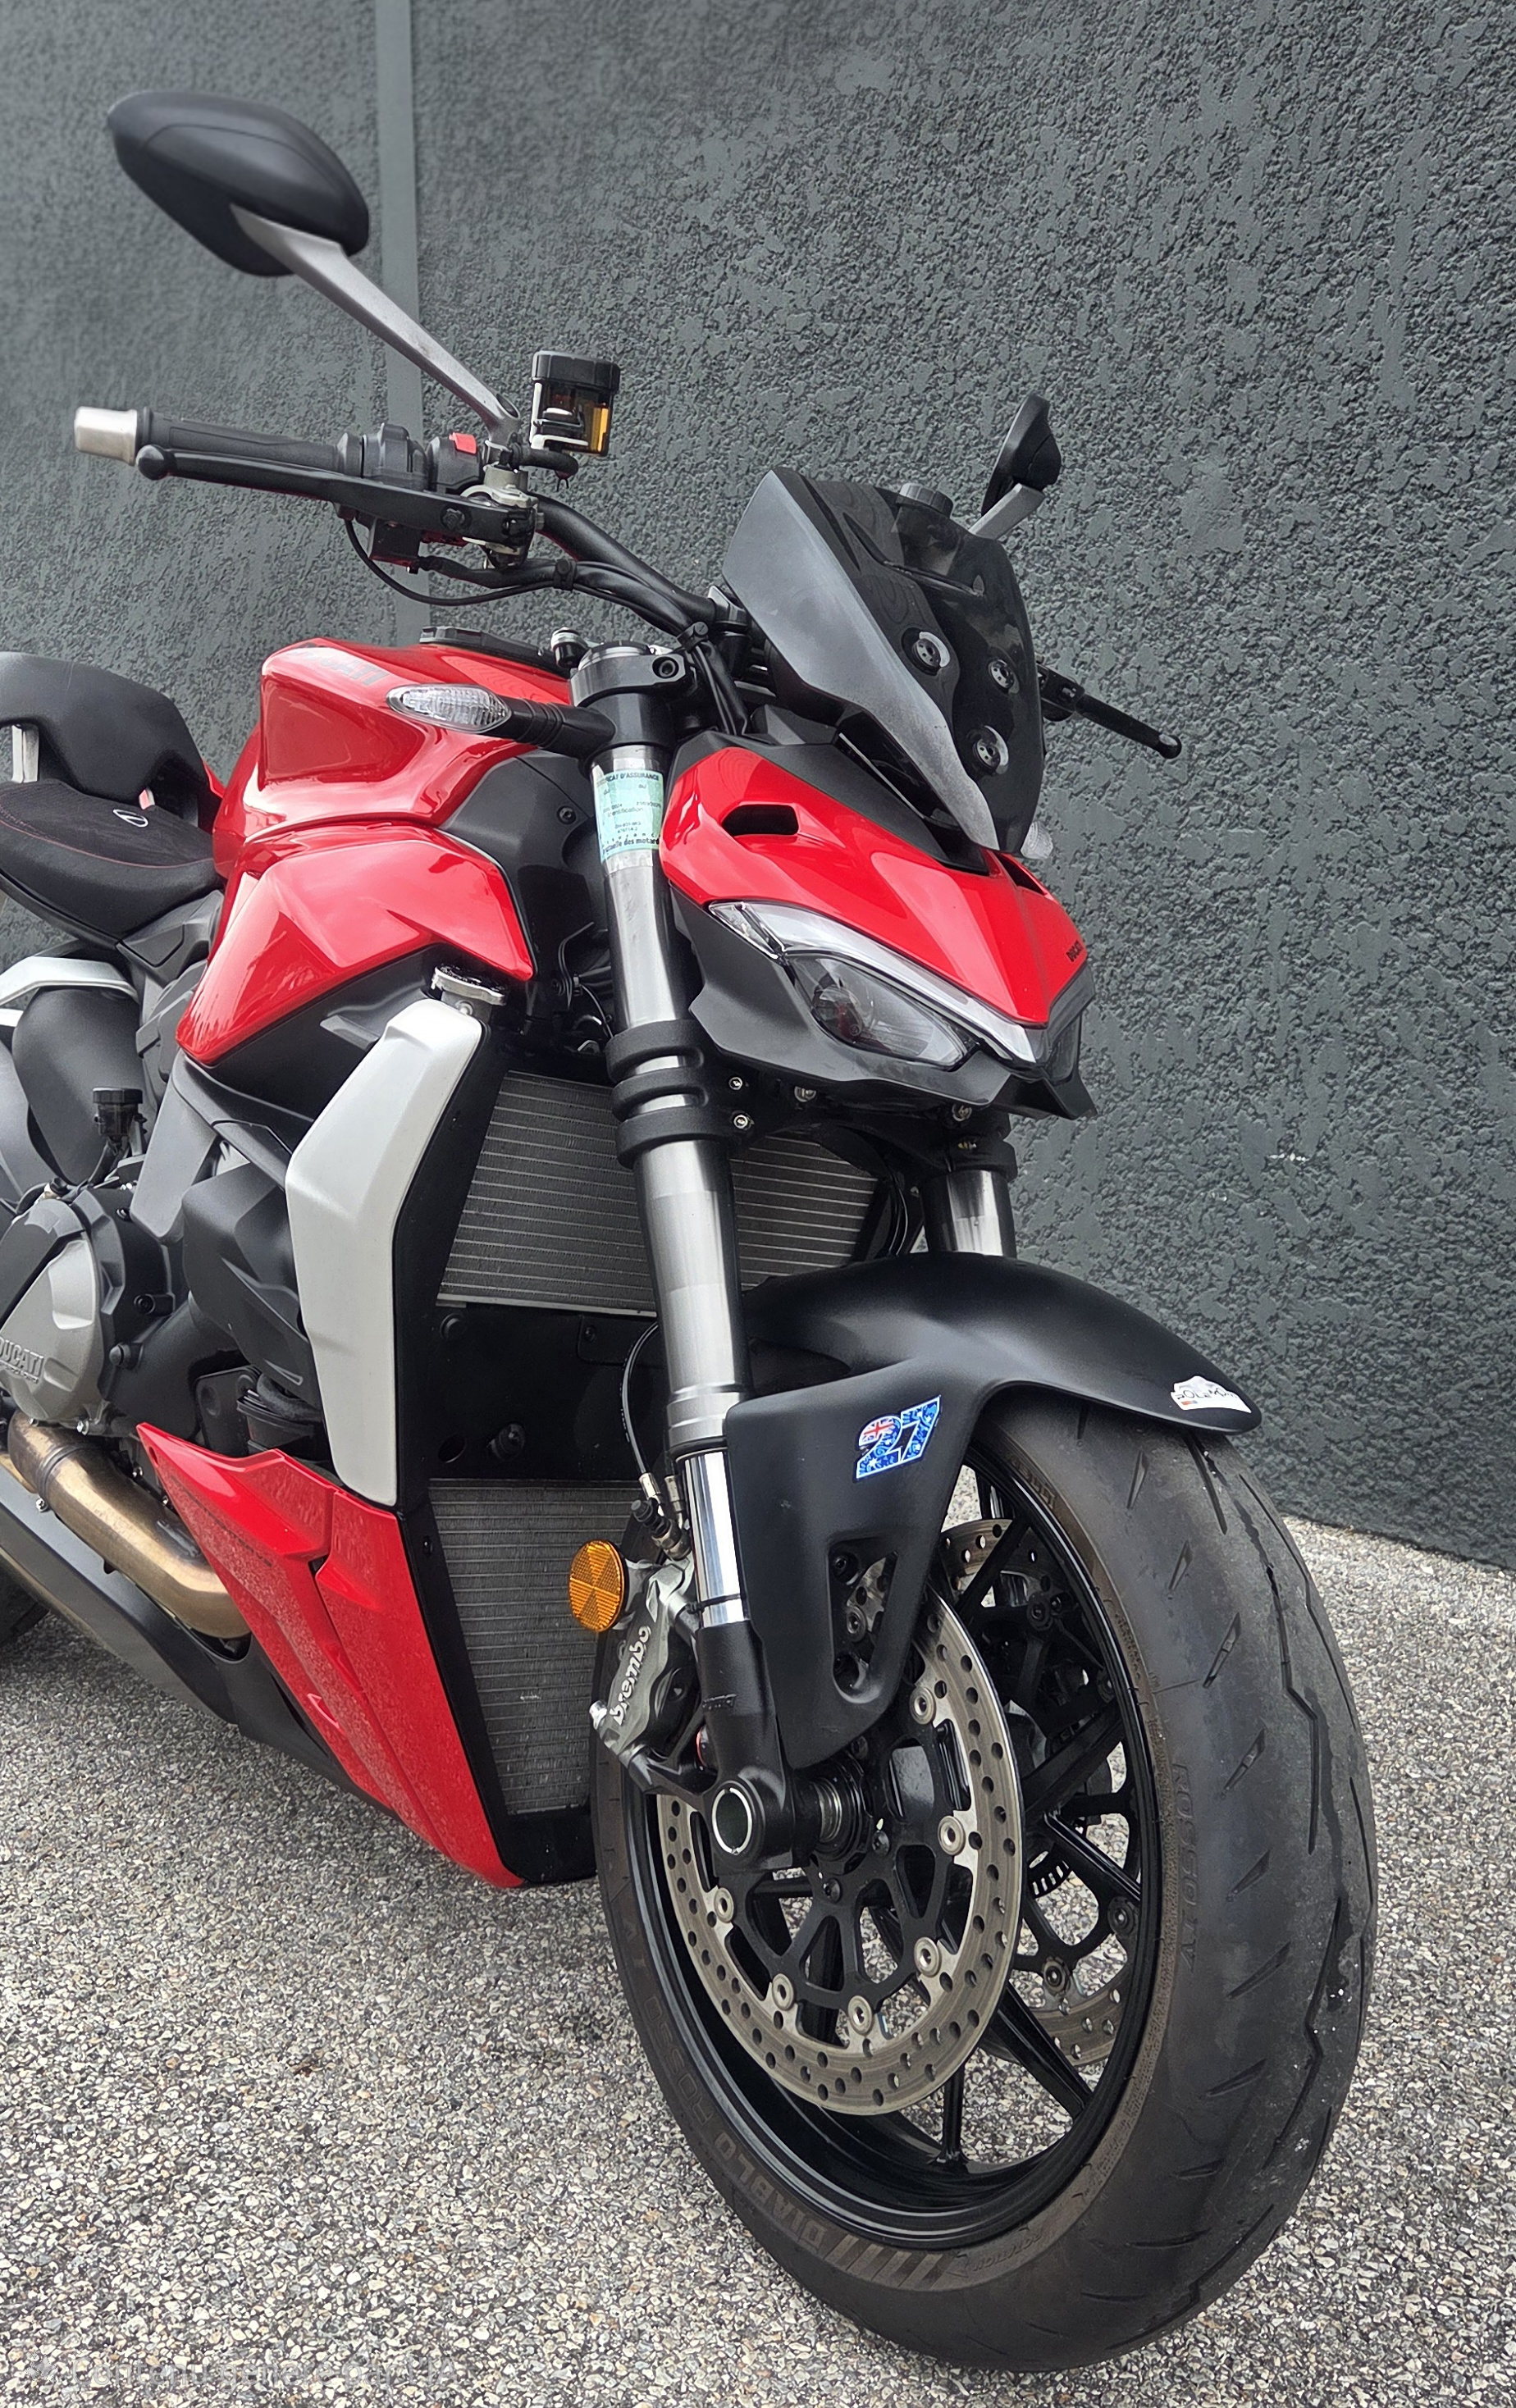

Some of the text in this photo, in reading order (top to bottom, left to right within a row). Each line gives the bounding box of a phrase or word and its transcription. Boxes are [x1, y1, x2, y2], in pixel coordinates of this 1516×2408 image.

[620, 772, 660, 782] D'ASSURANCE
[856, 1396, 940, 1480] 27
[609, 1625, 652, 1726] brembo
[643, 1995, 713, 2127] ROSSO
[714, 2132, 827, 2247] DIABLO
